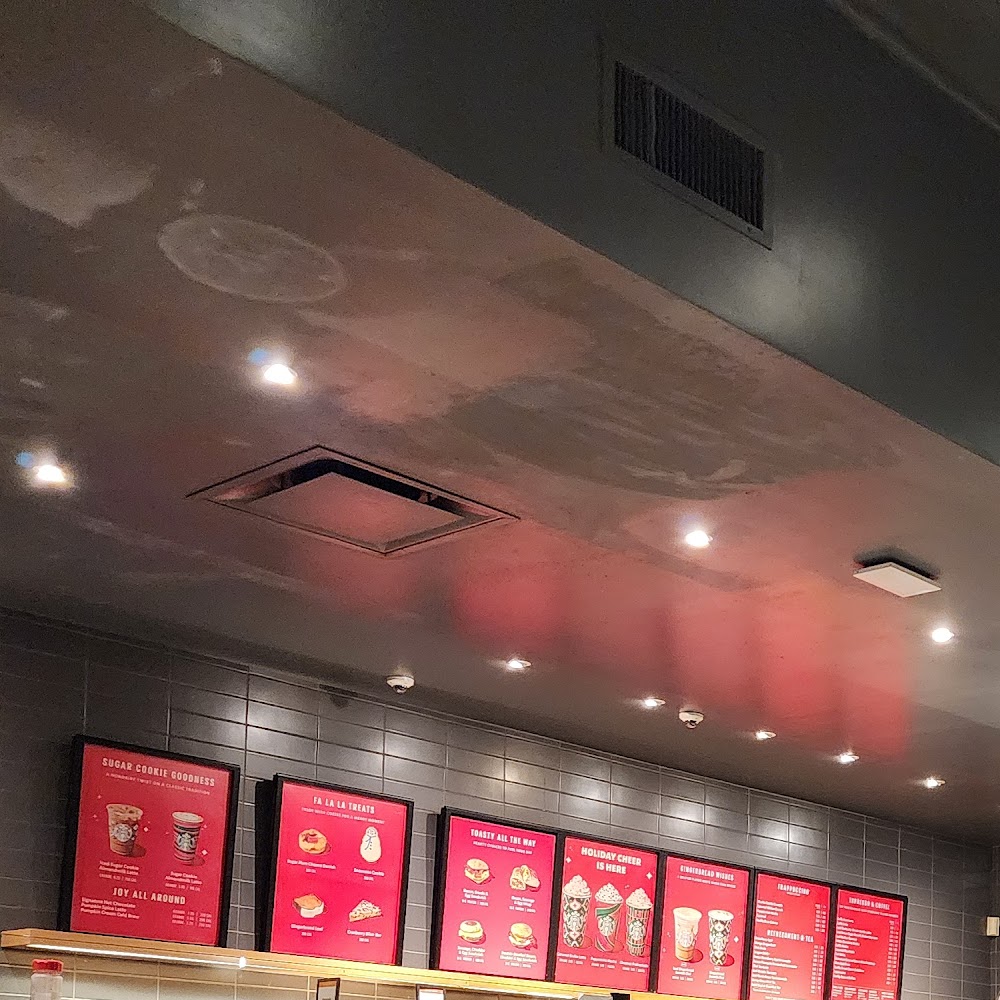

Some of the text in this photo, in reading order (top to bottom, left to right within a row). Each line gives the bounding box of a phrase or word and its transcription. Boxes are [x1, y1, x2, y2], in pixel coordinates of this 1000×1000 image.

[102, 758, 215, 787] SUGAR COOKIE GOODNESS
[313, 796, 375, 814] FA LA LA TREATS
[470, 828, 537, 848] TOASTY ALL THE WAY
[581, 846, 642, 867] HOLIDAY CHEER
[596, 861, 627, 875] IS HERE
[113, 887, 186, 905] JOY ALL AROUND
